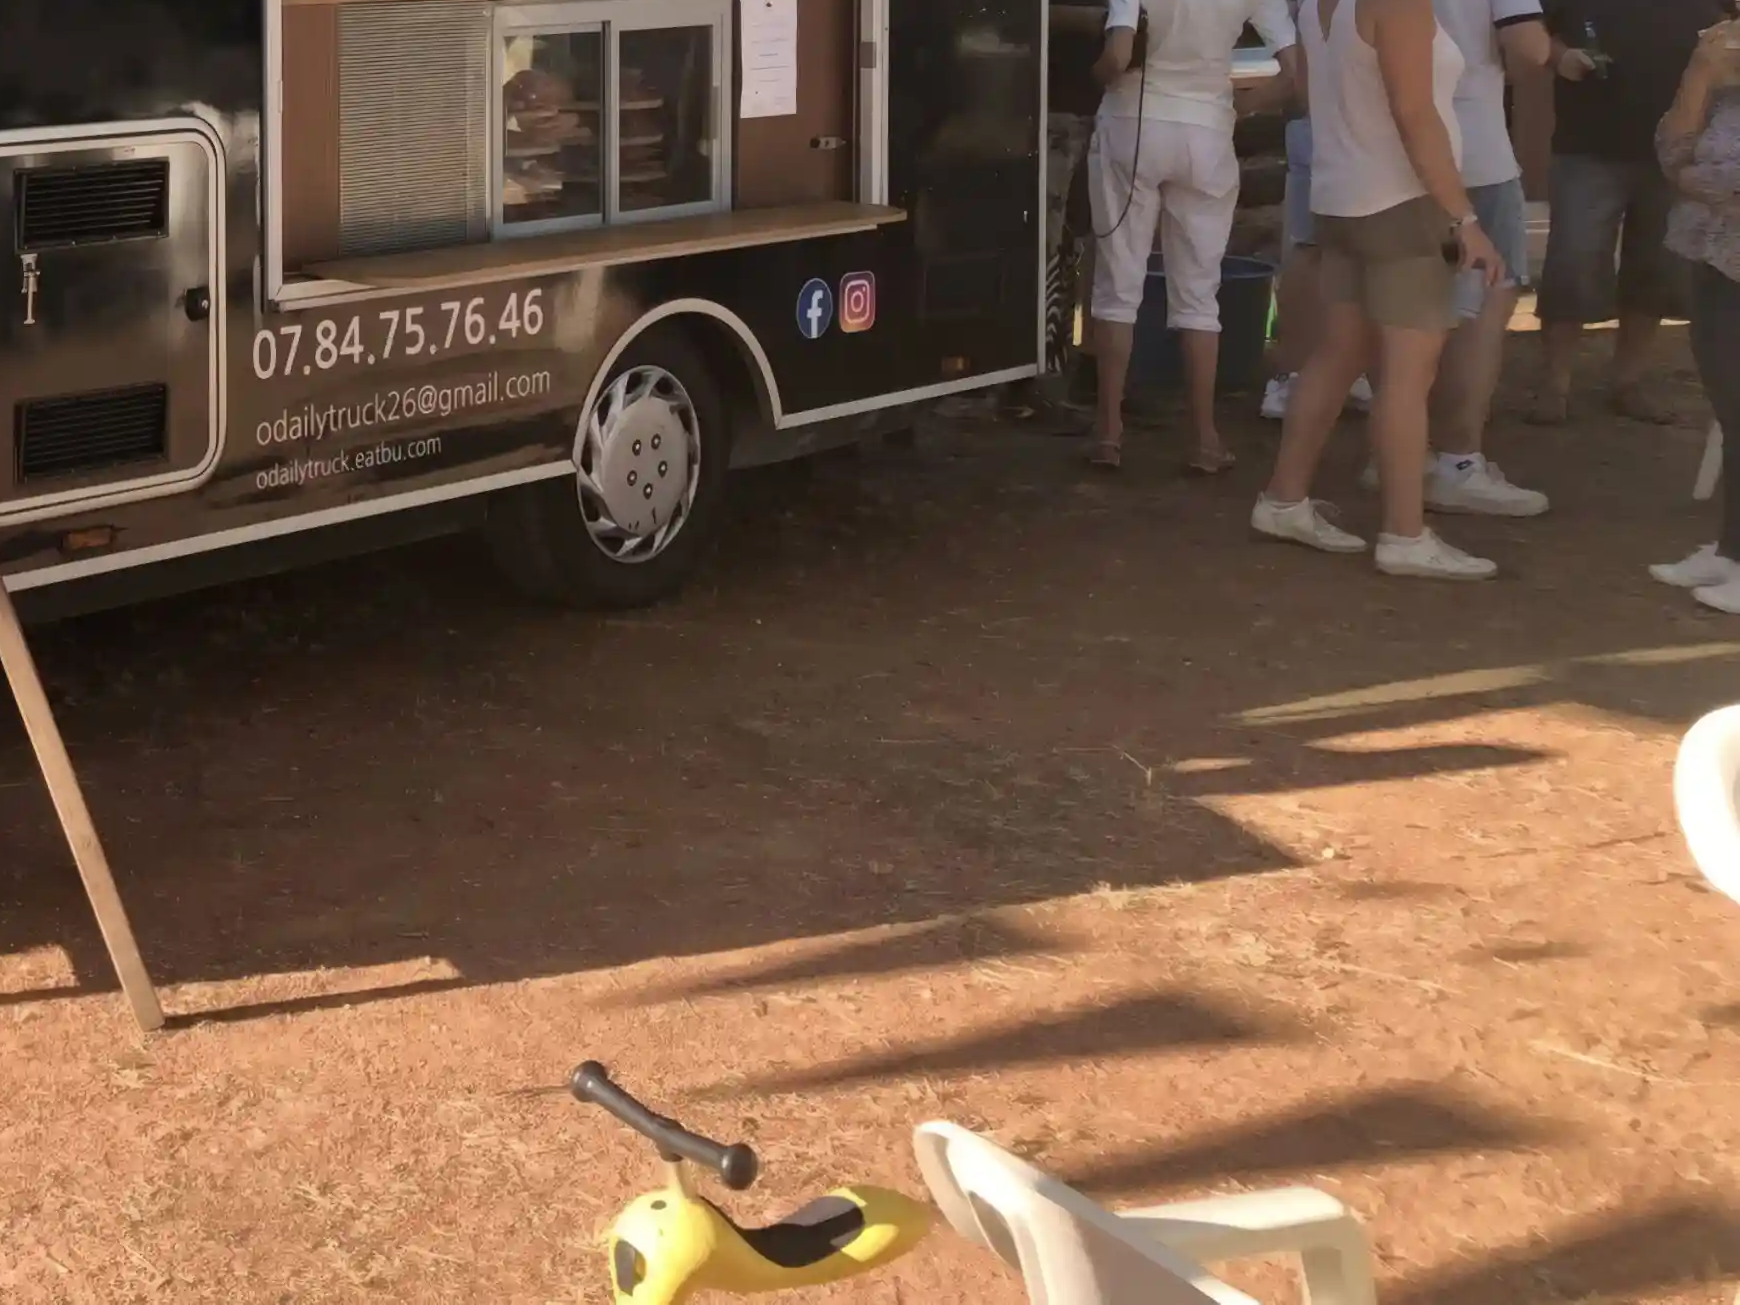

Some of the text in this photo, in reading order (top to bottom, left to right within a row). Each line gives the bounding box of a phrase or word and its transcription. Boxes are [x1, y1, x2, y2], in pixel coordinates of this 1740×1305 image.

[252, 288, 544, 380] 07.84.75.76.46
[256, 369, 551, 446] odailytruck26@gmail.com
[255, 434, 442, 490] odailytruck.eatbu.com
